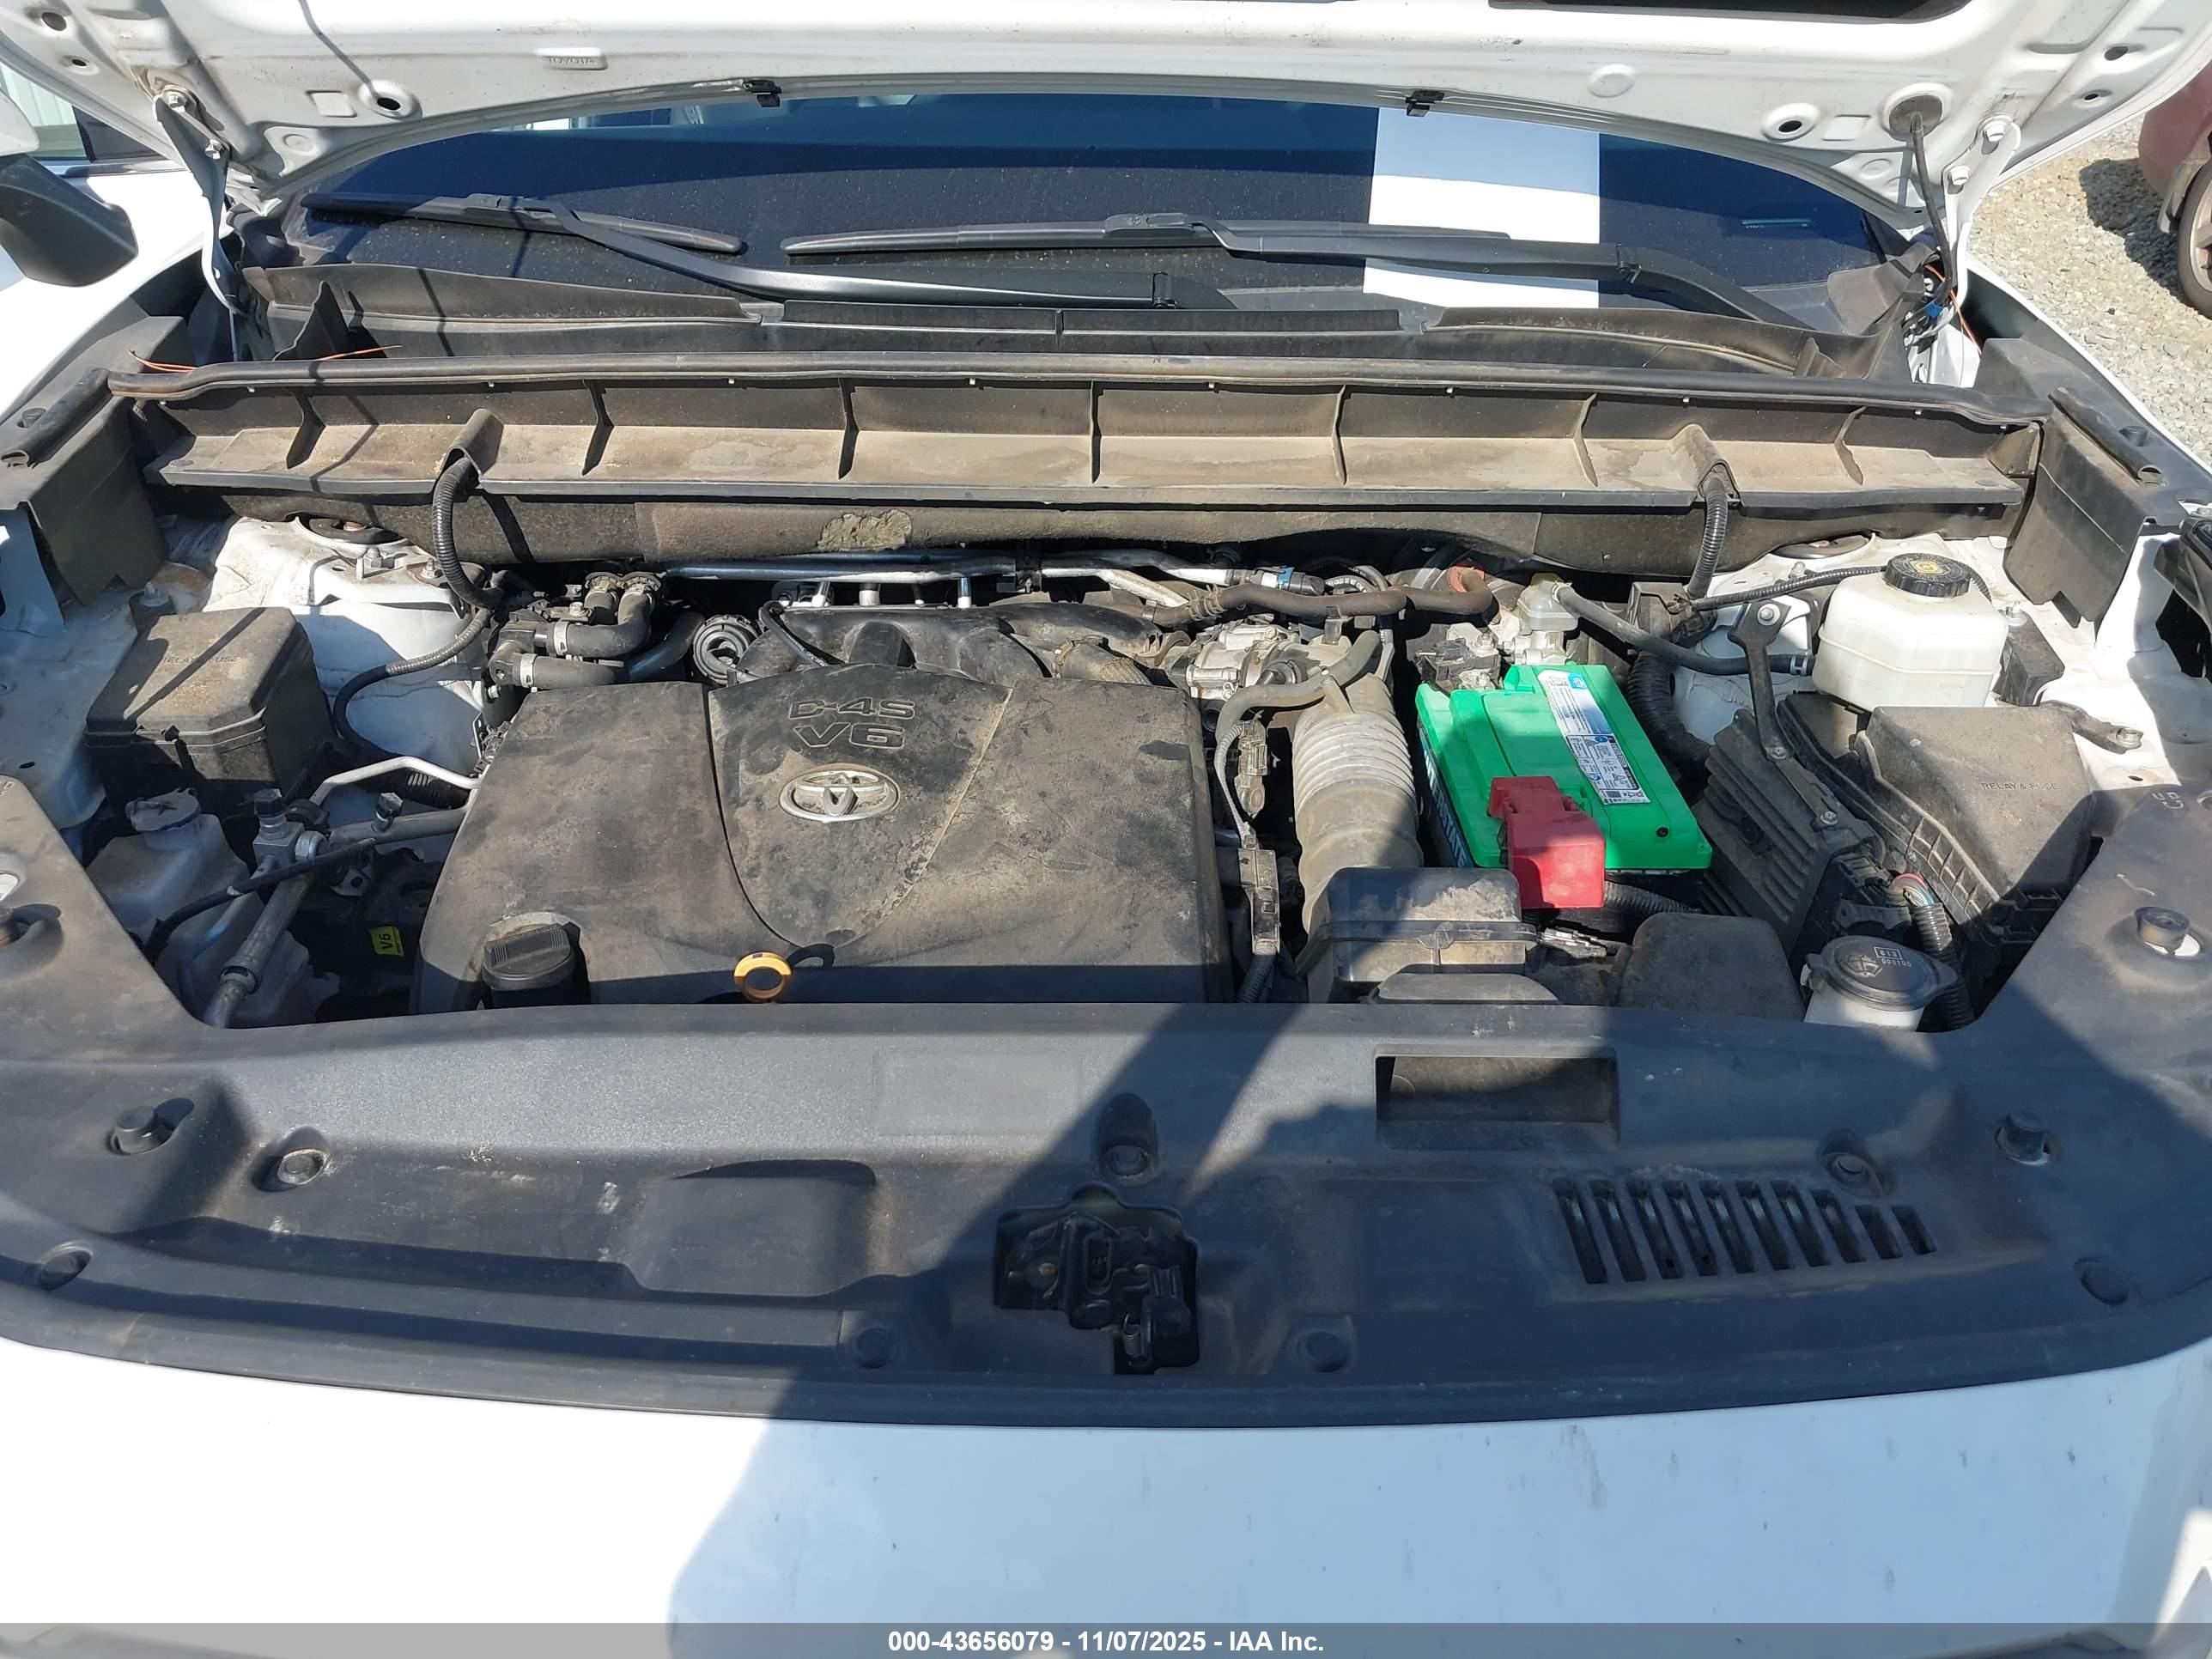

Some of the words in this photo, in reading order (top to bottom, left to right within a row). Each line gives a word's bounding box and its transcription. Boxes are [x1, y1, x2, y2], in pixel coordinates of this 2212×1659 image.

[788, 696, 915, 720] D-4S
[793, 722, 905, 749] V6
[378, 933, 393, 950] V6
